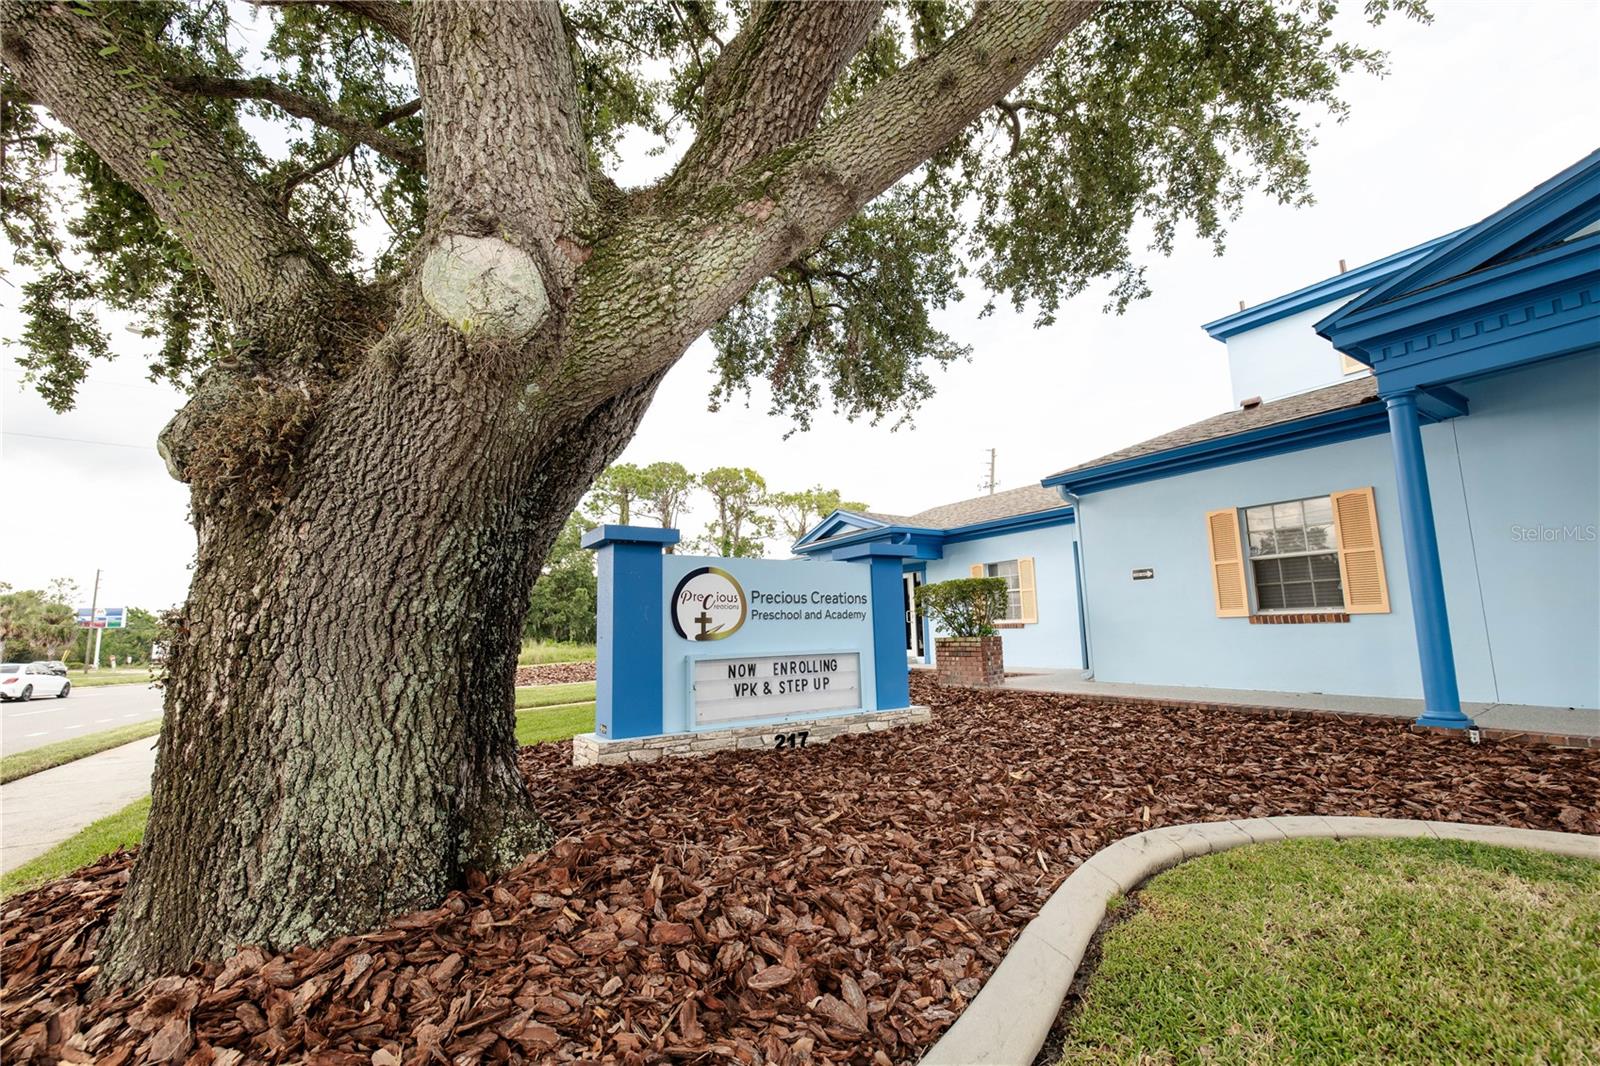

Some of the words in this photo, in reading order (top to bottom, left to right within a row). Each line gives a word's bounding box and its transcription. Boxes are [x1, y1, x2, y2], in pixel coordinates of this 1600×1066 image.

[751, 590, 808, 604] Precious
[810, 591, 868, 605] Creations
[751, 609, 802, 620] Preschool
[804, 610, 822, 620] and
[824, 610, 867, 621] Academy
[728, 663, 757, 679] NOW
[773, 659, 838, 676] ENROLLING
[734, 682, 758, 697] VPK
[763, 681, 772, 695] &
[779, 679, 808, 694] STEP
[813, 677, 830, 690] UP
[774, 731, 809, 749] 217
